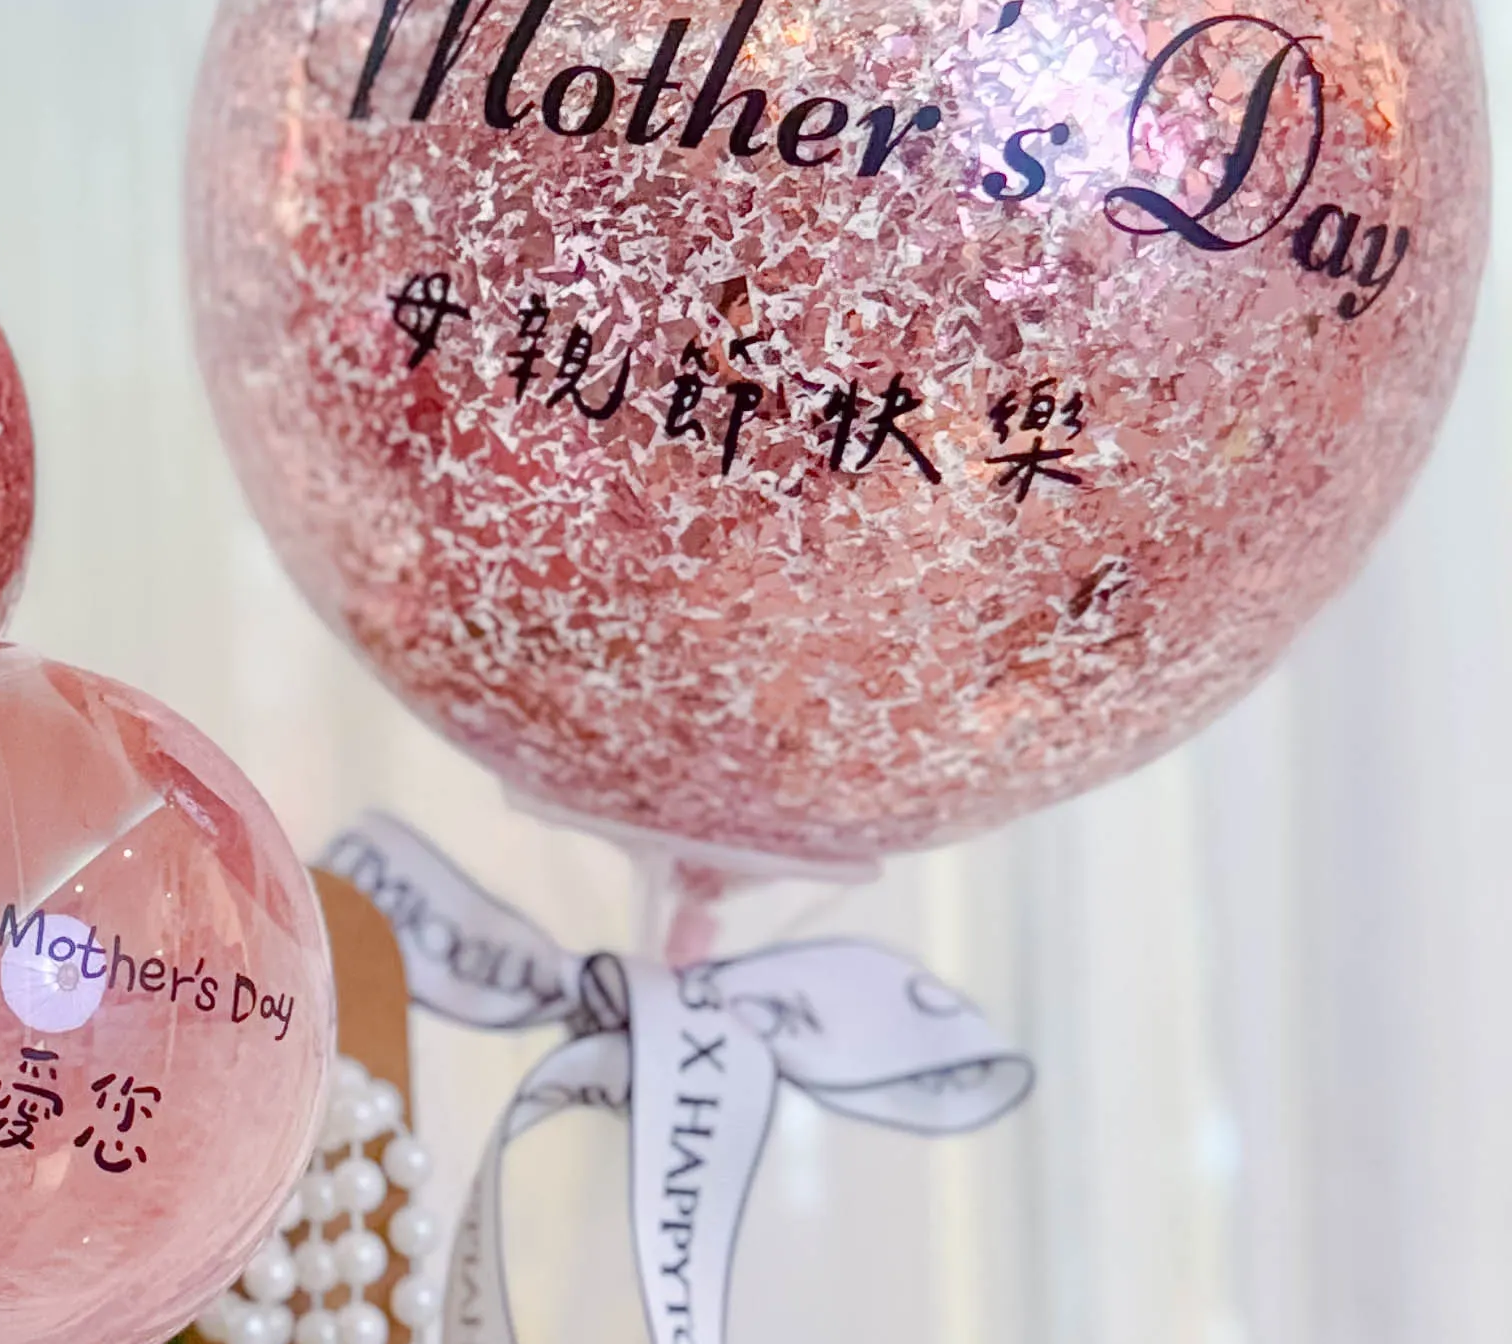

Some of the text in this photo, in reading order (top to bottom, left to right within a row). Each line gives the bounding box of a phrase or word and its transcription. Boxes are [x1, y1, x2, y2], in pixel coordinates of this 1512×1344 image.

[1102, 13, 1411, 321] Day
[388, 271, 1098, 503] 母親節快樂
[231, 973, 295, 1042] Day
